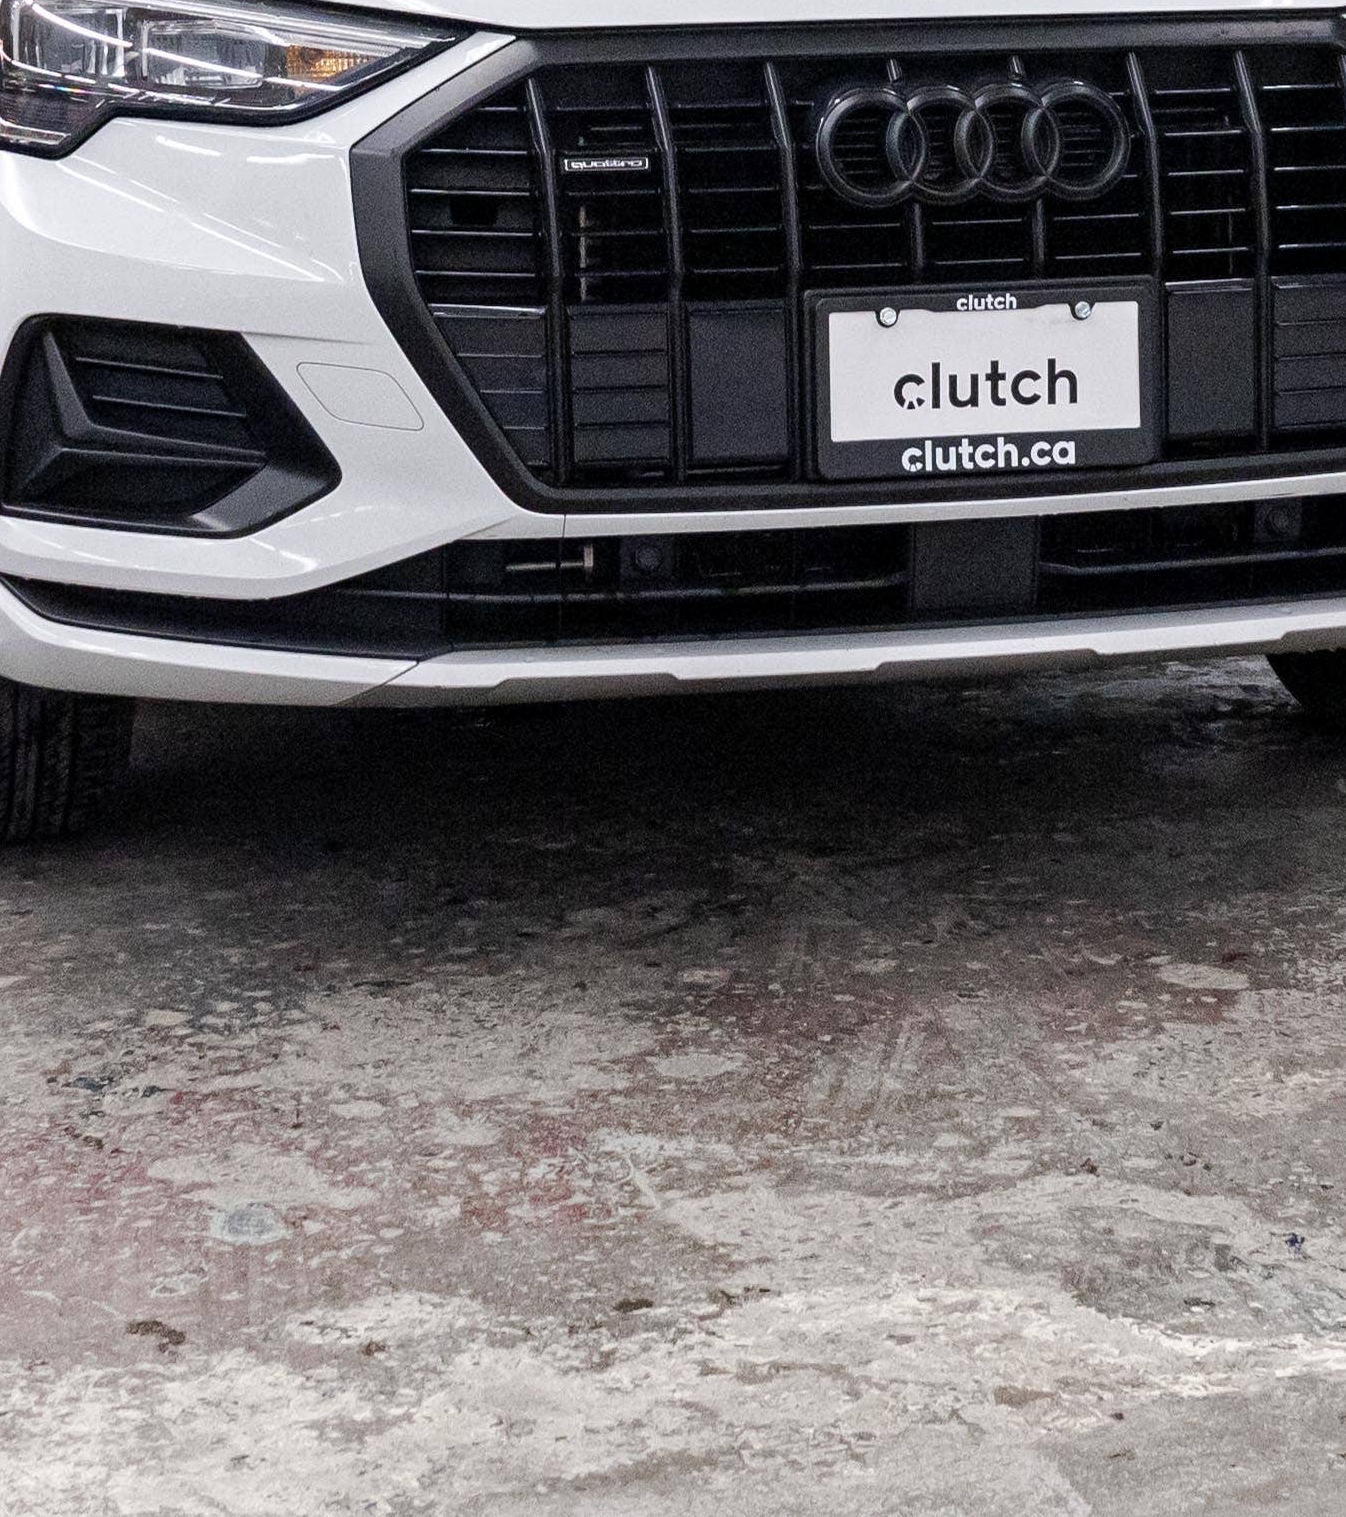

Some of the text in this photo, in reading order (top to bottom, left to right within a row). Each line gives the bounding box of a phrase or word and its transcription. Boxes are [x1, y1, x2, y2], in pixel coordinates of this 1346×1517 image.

[571, 159, 643, 170] quattro
[956, 293, 1017, 311] clutch
[894, 357, 1078, 410] clutch
[901, 436, 1076, 472] clutch.ca
